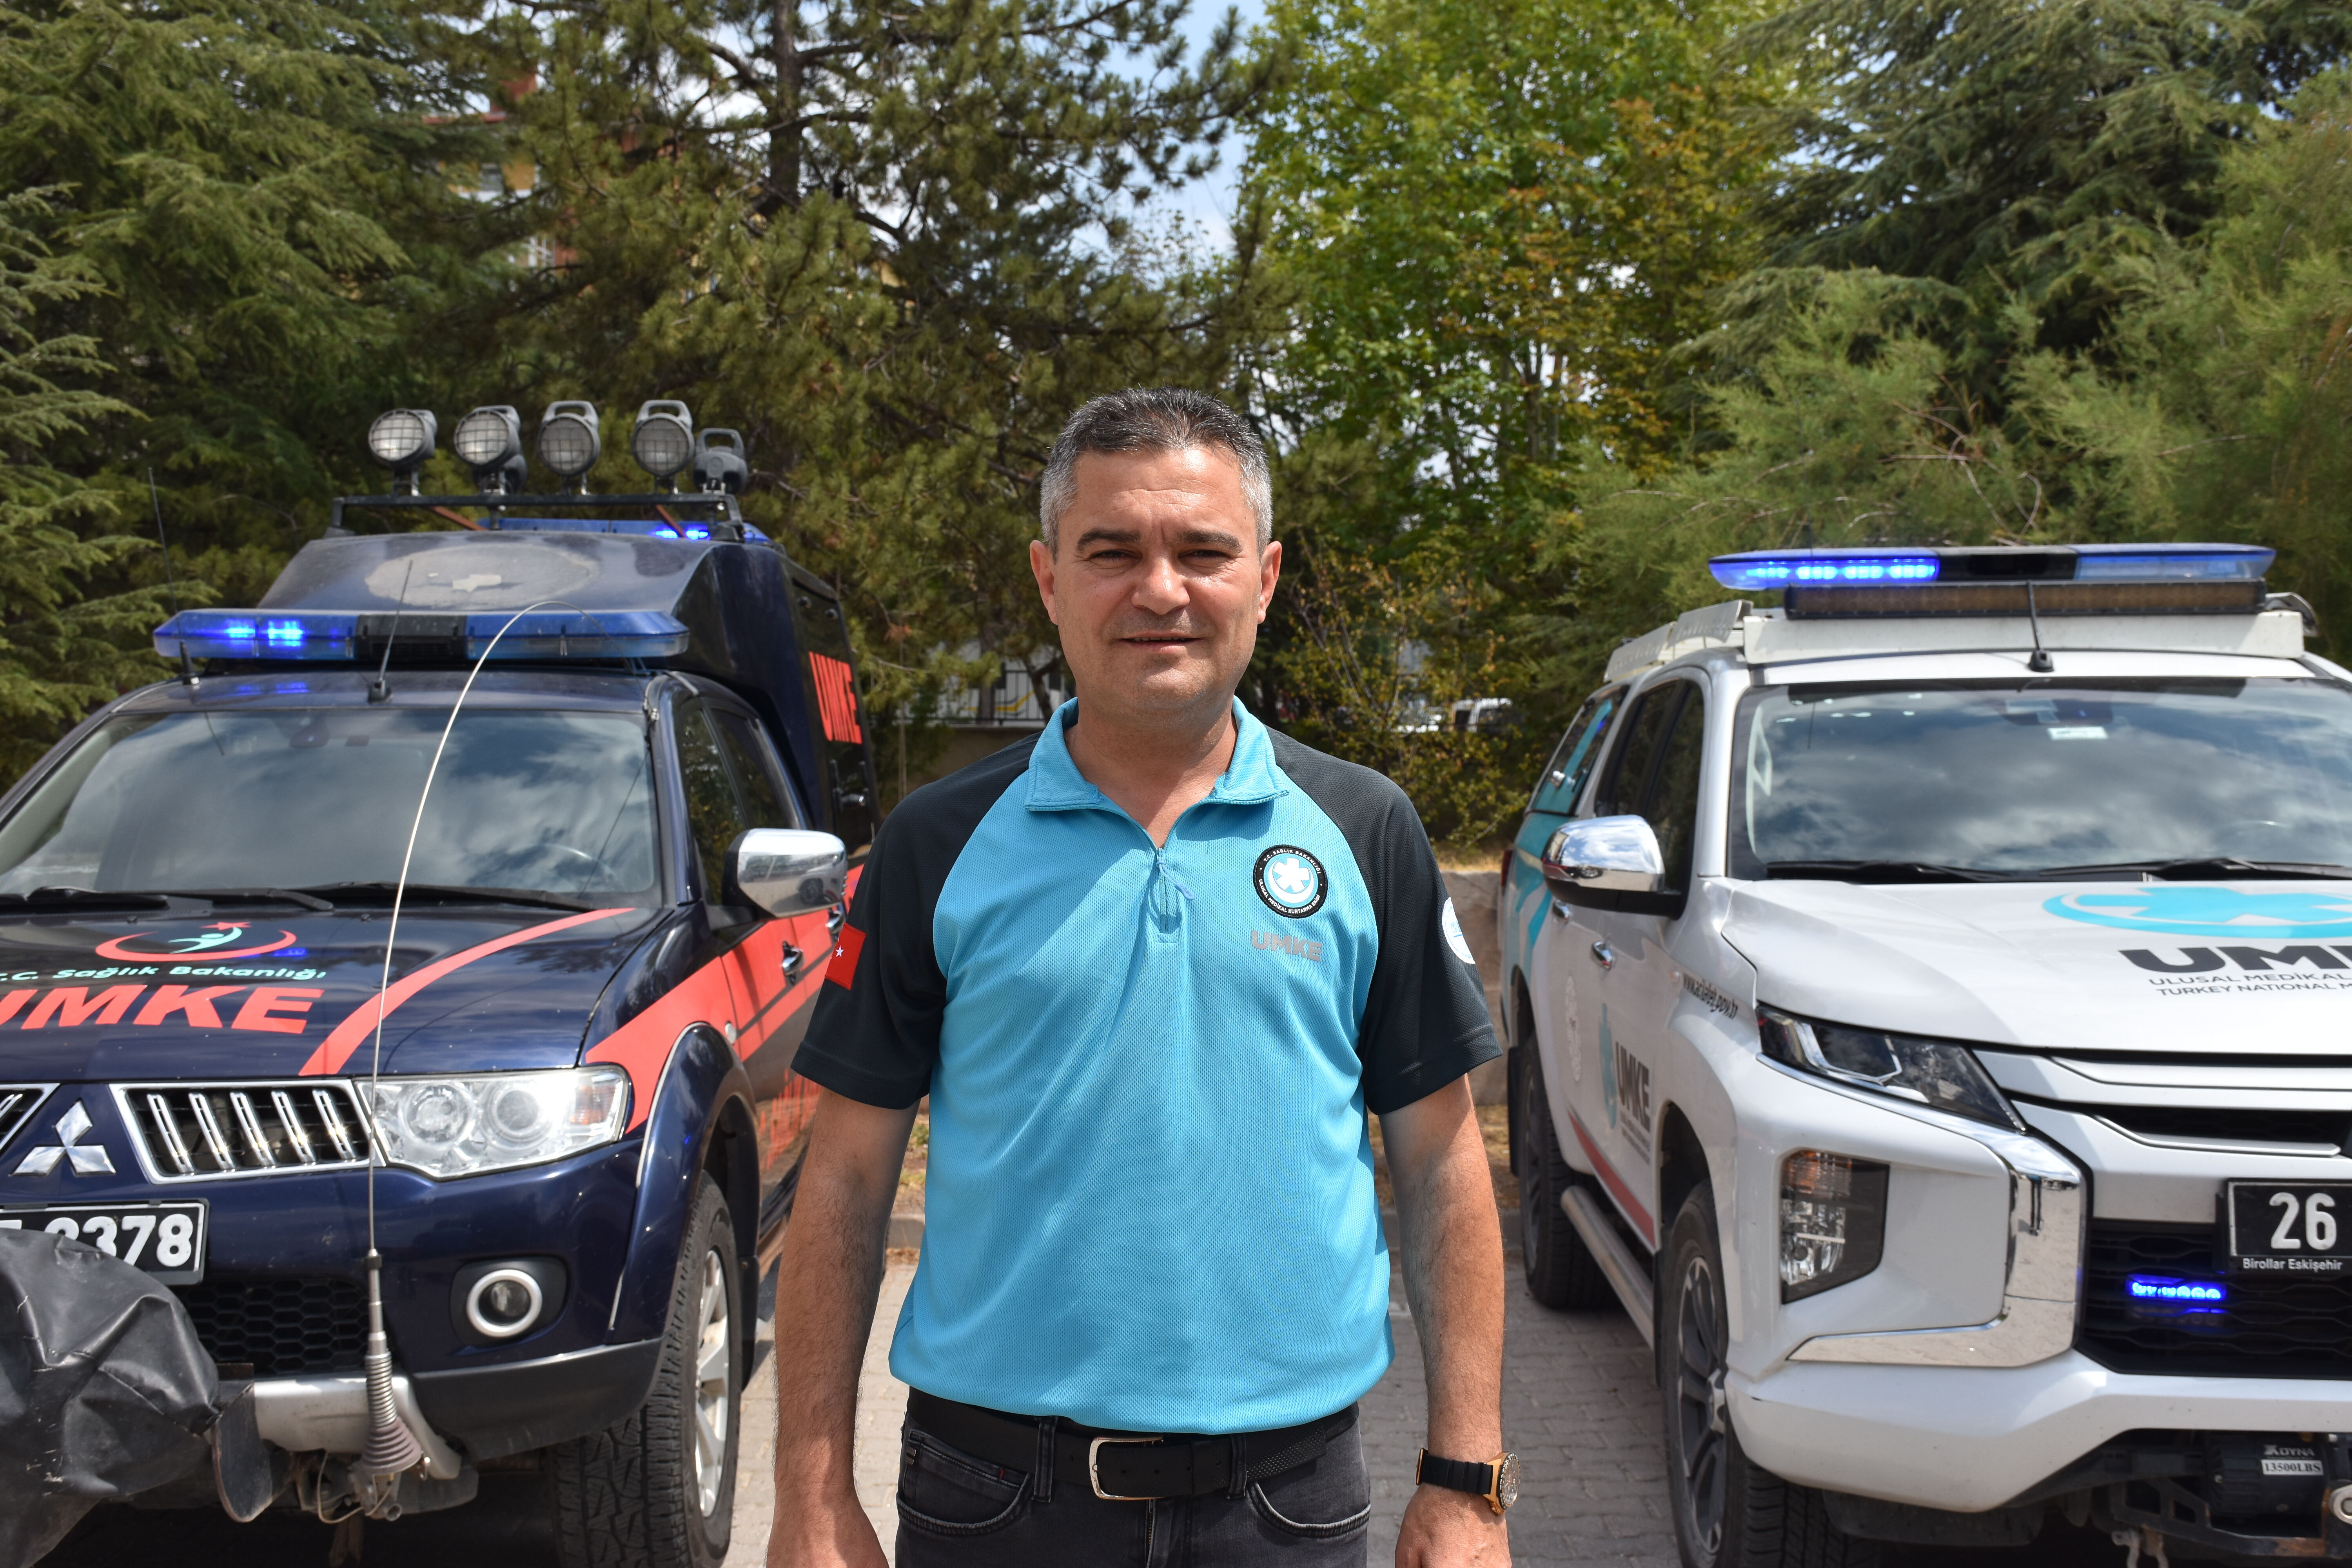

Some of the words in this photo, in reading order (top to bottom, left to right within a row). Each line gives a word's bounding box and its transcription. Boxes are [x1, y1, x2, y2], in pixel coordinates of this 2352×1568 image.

[809, 651, 862, 744] UMKE
[1295, 851, 1321, 874] BAKANLIĞI
[1258, 879, 1269, 898] ULUSAL
[1268, 897, 1287, 913] MEDİKAL
[1288, 904, 1313, 914] KURTARMA
[1311, 894, 1321, 906] EKİBİ
[1251, 930, 1323, 962] UMKE
[52, 966, 160, 979] Sağlık
[169, 966, 327, 980] Bakanlığı
[2148, 975, 2241, 985] ULUSAL
[2156, 985, 2232, 996] TURKEY
[2237, 982, 2337, 992] NATIONAL
[1615, 1040, 1650, 1134] UMKE
[2269, 1192, 2337, 1250] 26
[2243, 1258, 2286, 1269] Birollar
[2288, 1258, 2343, 1273] Eskişehir
